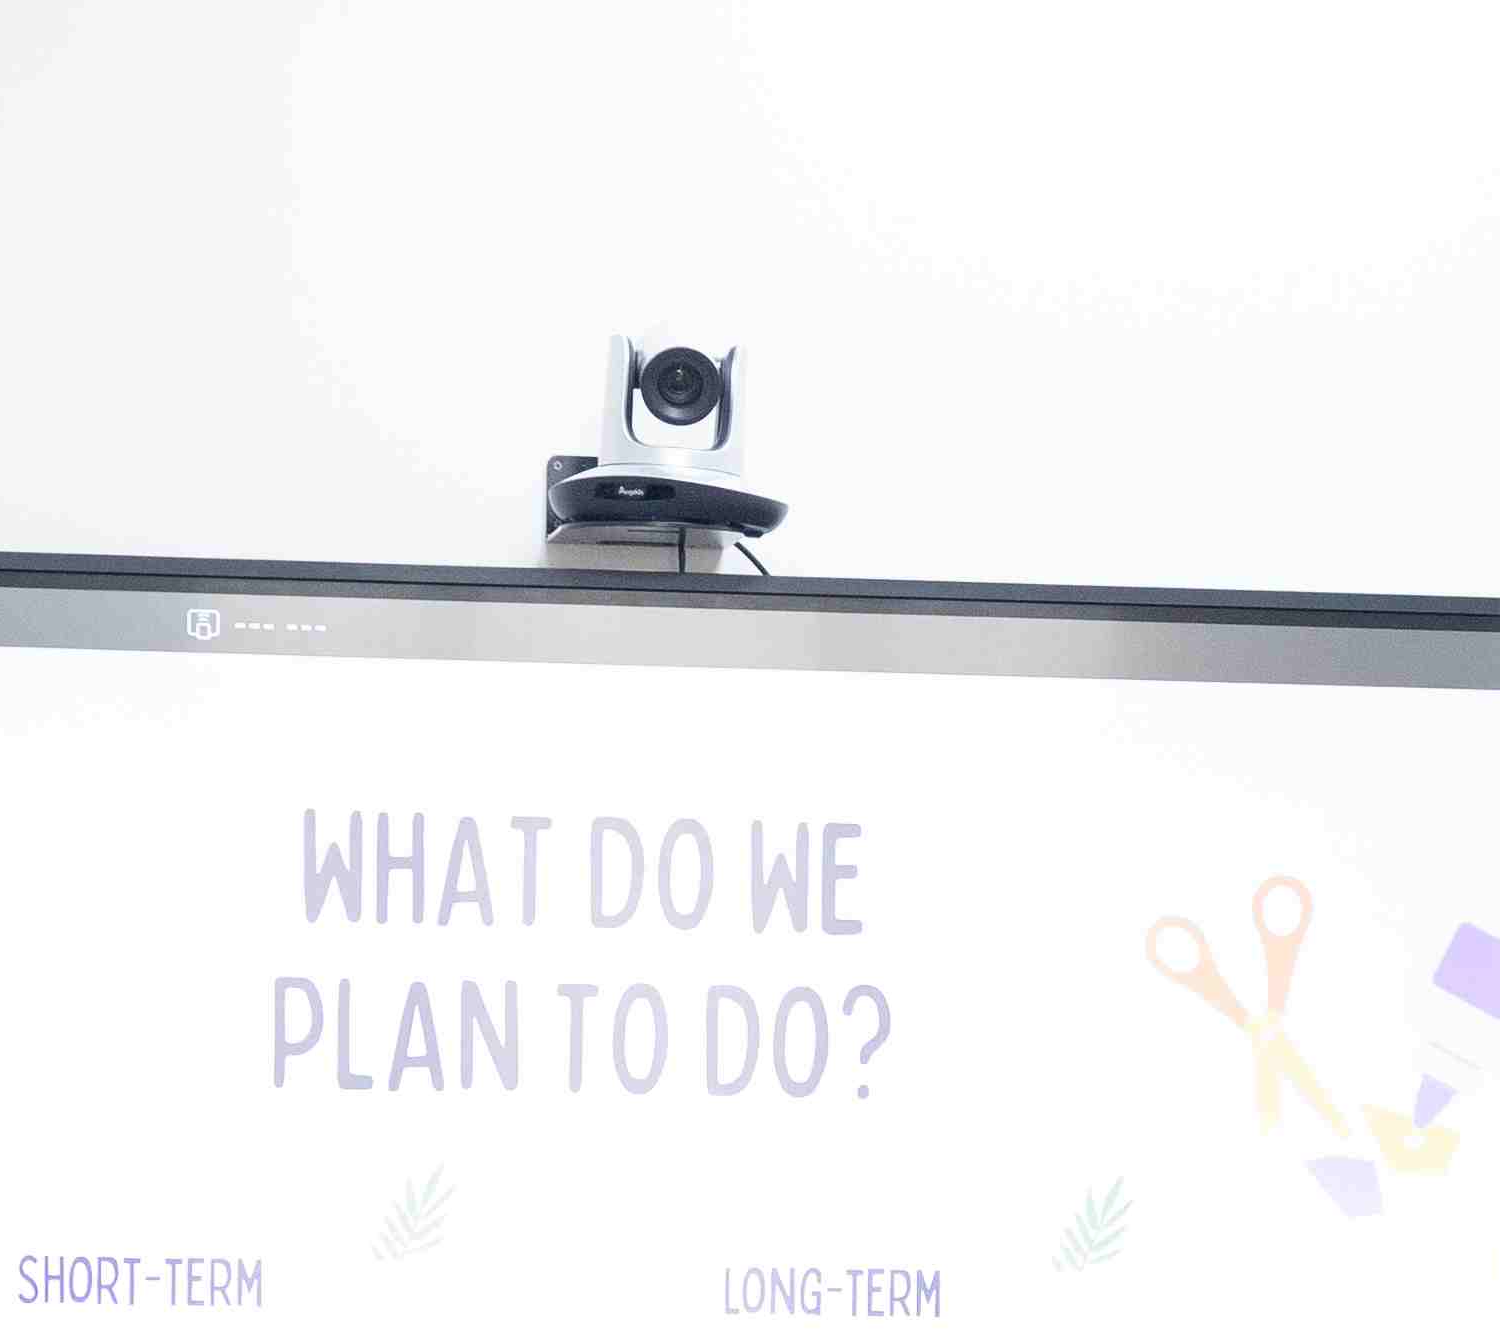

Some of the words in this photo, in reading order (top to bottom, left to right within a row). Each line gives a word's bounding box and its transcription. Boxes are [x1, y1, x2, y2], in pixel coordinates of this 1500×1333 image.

[303, 808, 552, 926] WHAT
[590, 816, 714, 930] DO
[750, 819, 863, 936] WE
[273, 976, 519, 1092] PLAN
[557, 983, 668, 1095] TO
[705, 984, 892, 1099] DO?
[17, 1254, 264, 1307] SHORT-TERM
[724, 1266, 942, 1318] LONG-TERM
